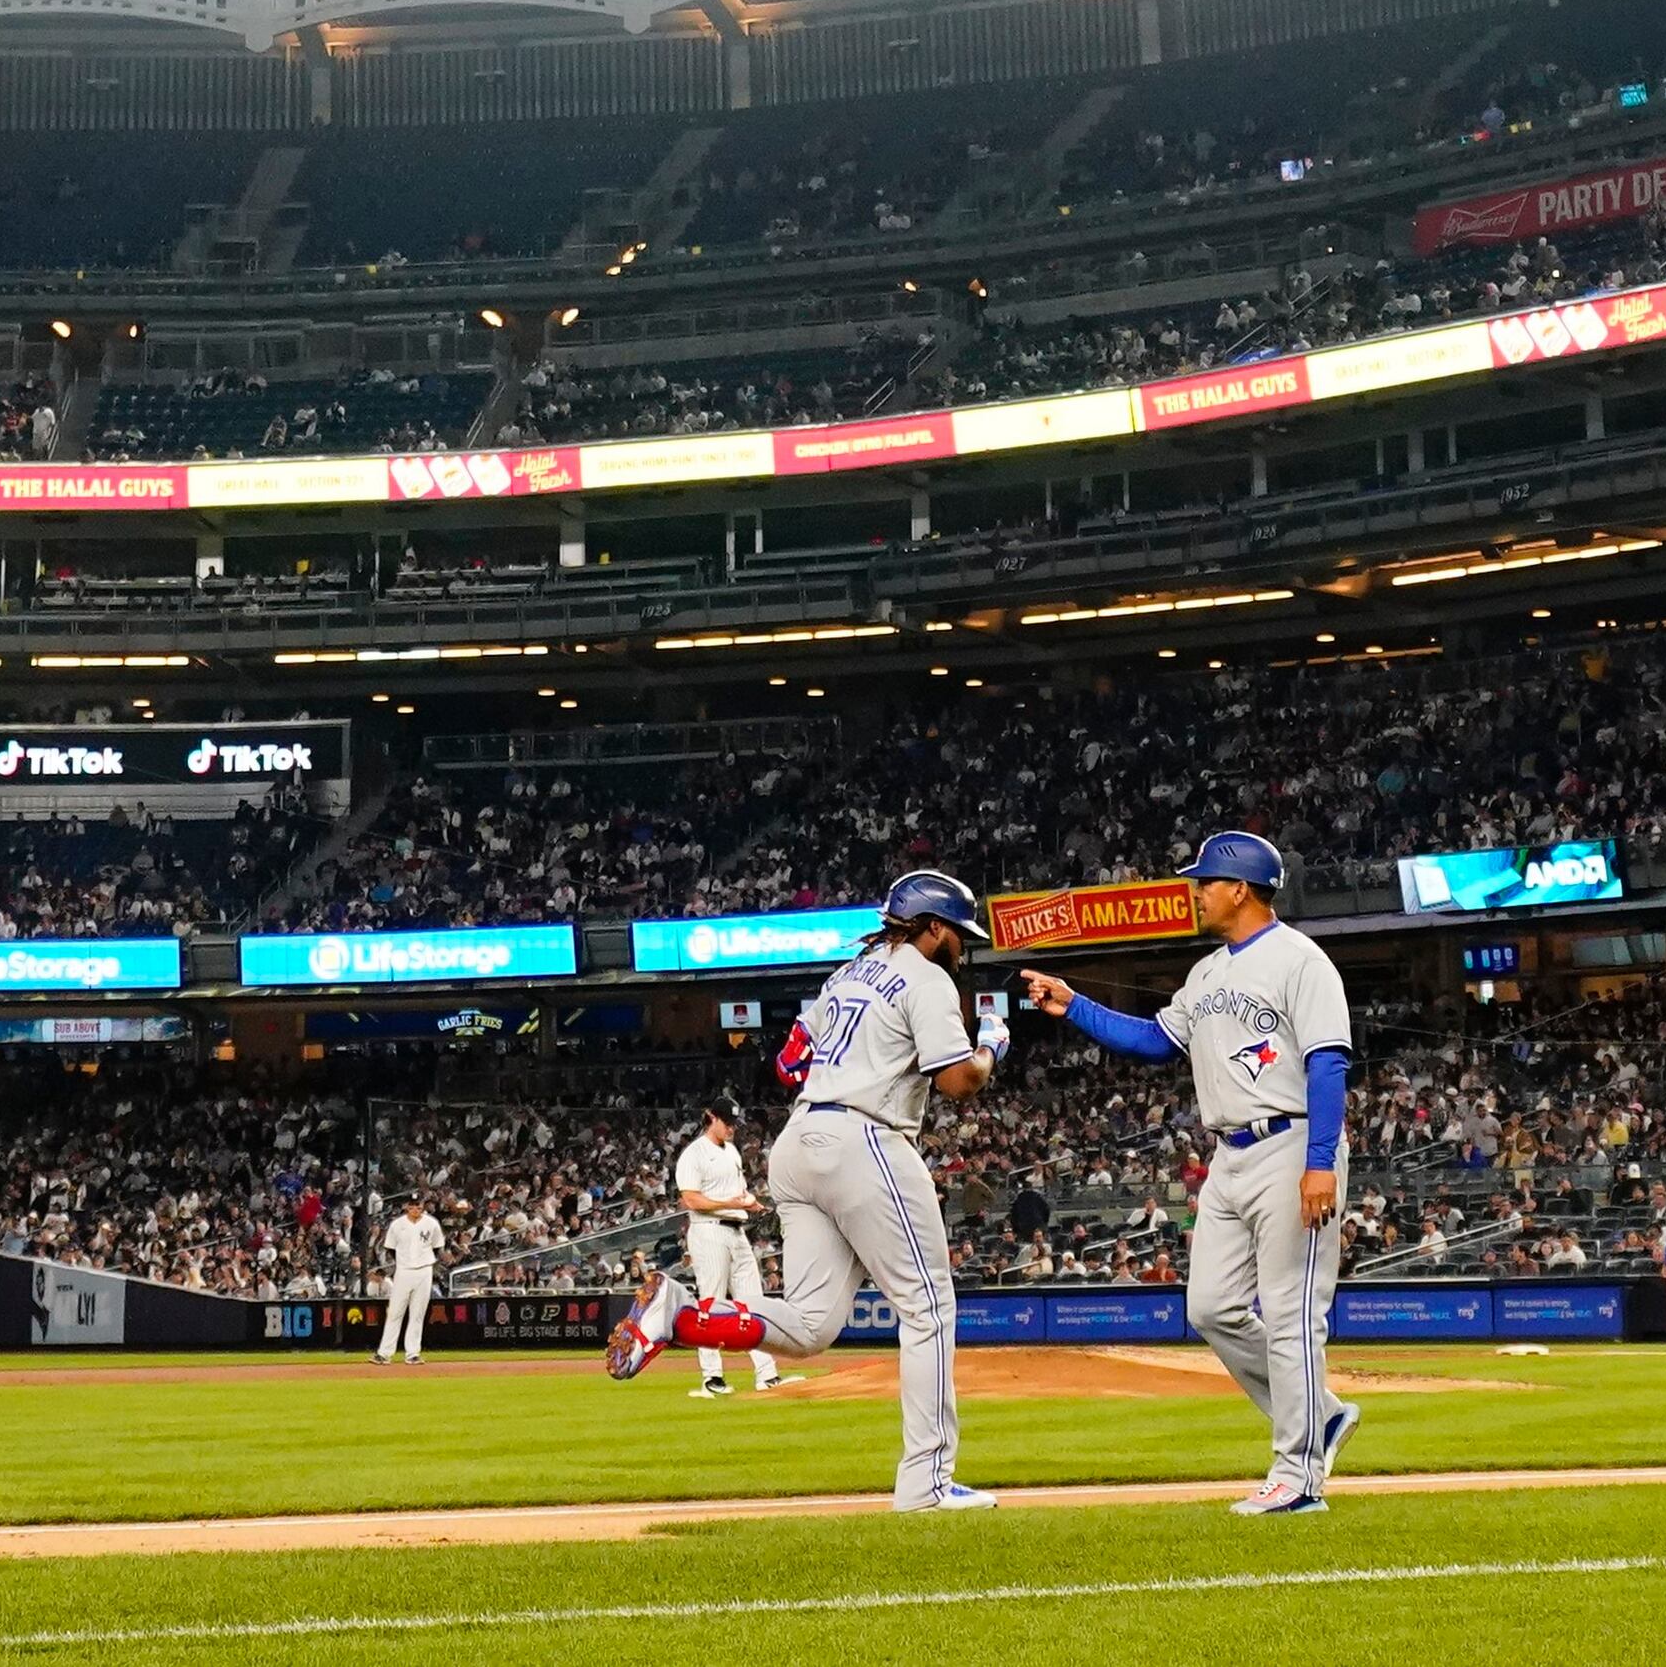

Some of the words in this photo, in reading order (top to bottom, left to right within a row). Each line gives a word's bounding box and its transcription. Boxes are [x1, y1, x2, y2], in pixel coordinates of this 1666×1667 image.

[1538, 177, 1624, 226] PARTY
[1608, 293, 1653, 328] Halal
[1153, 391, 1190, 416] THE
[1191, 381, 1249, 409] HALAL
[1251, 372, 1297, 398] GUYS
[514, 452, 558, 478] Halal
[0, 478, 44, 498] THE
[47, 478, 116, 498] HALAL
[119, 478, 174, 498] GUYS
[26, 747, 123, 775] TikTok
[219, 743, 312, 773] TikTok
[1525, 858, 1585, 889] AMD
[1010, 904, 1071, 941] MIKE'S
[1082, 894, 1188, 929] AMAZING
[875, 974, 906, 1008] JR.
[437, 1015, 472, 1032] GARLIC
[475, 1015, 503, 1030] FRIES
[1190, 988, 1279, 1034] ORONTO
[54, 1022, 71, 1033] SUB
[73, 1022, 101, 1033] ABOVE
[811, 995, 871, 1066] 27
[484, 1326, 497, 1338] BIG
[520, 1326, 535, 1338] BIG
[565, 1326, 580, 1338] BIG
